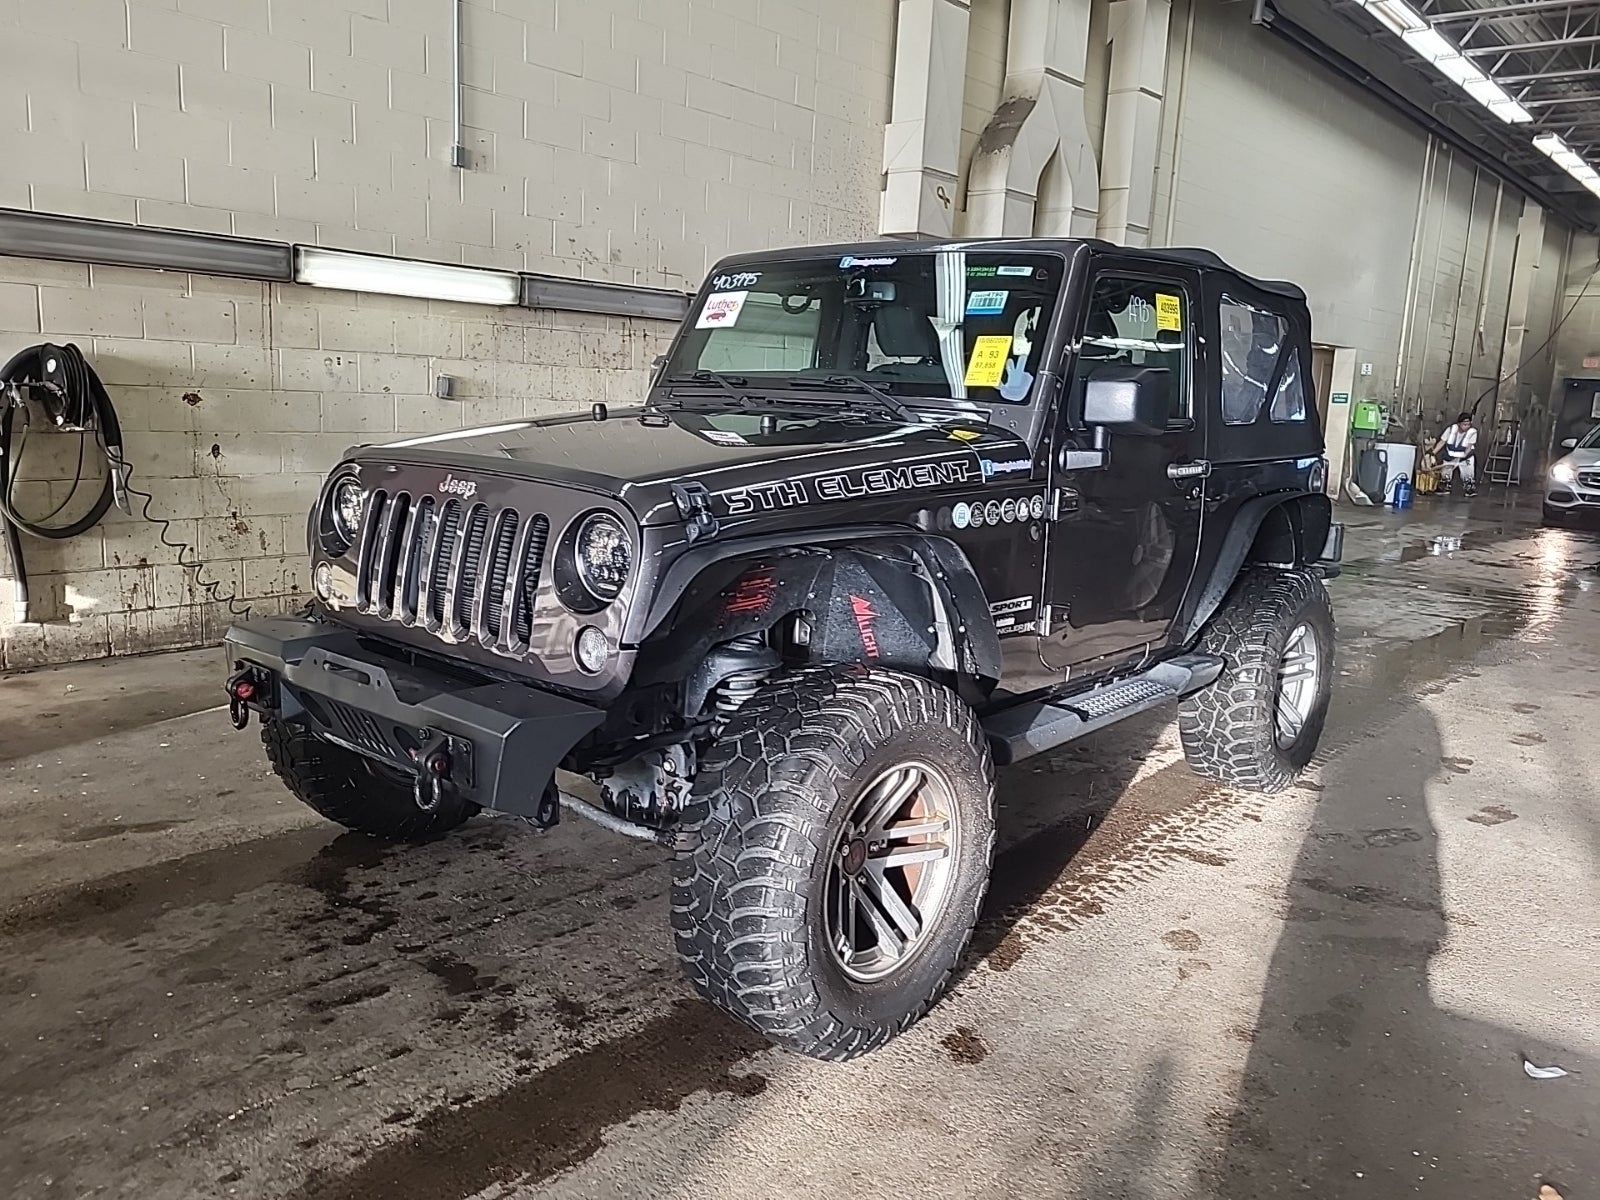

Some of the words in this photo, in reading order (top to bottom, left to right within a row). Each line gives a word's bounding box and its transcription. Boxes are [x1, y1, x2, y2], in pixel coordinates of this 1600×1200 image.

[713, 272, 763, 290] 403995
[707, 299, 738, 311] Luther
[989, 350, 999, 358] 93
[438, 473, 477, 500] Jeep
[722, 480, 809, 515] 5TH
[815, 460, 969, 500] ELEMENT
[991, 600, 1029, 613] SPORT
